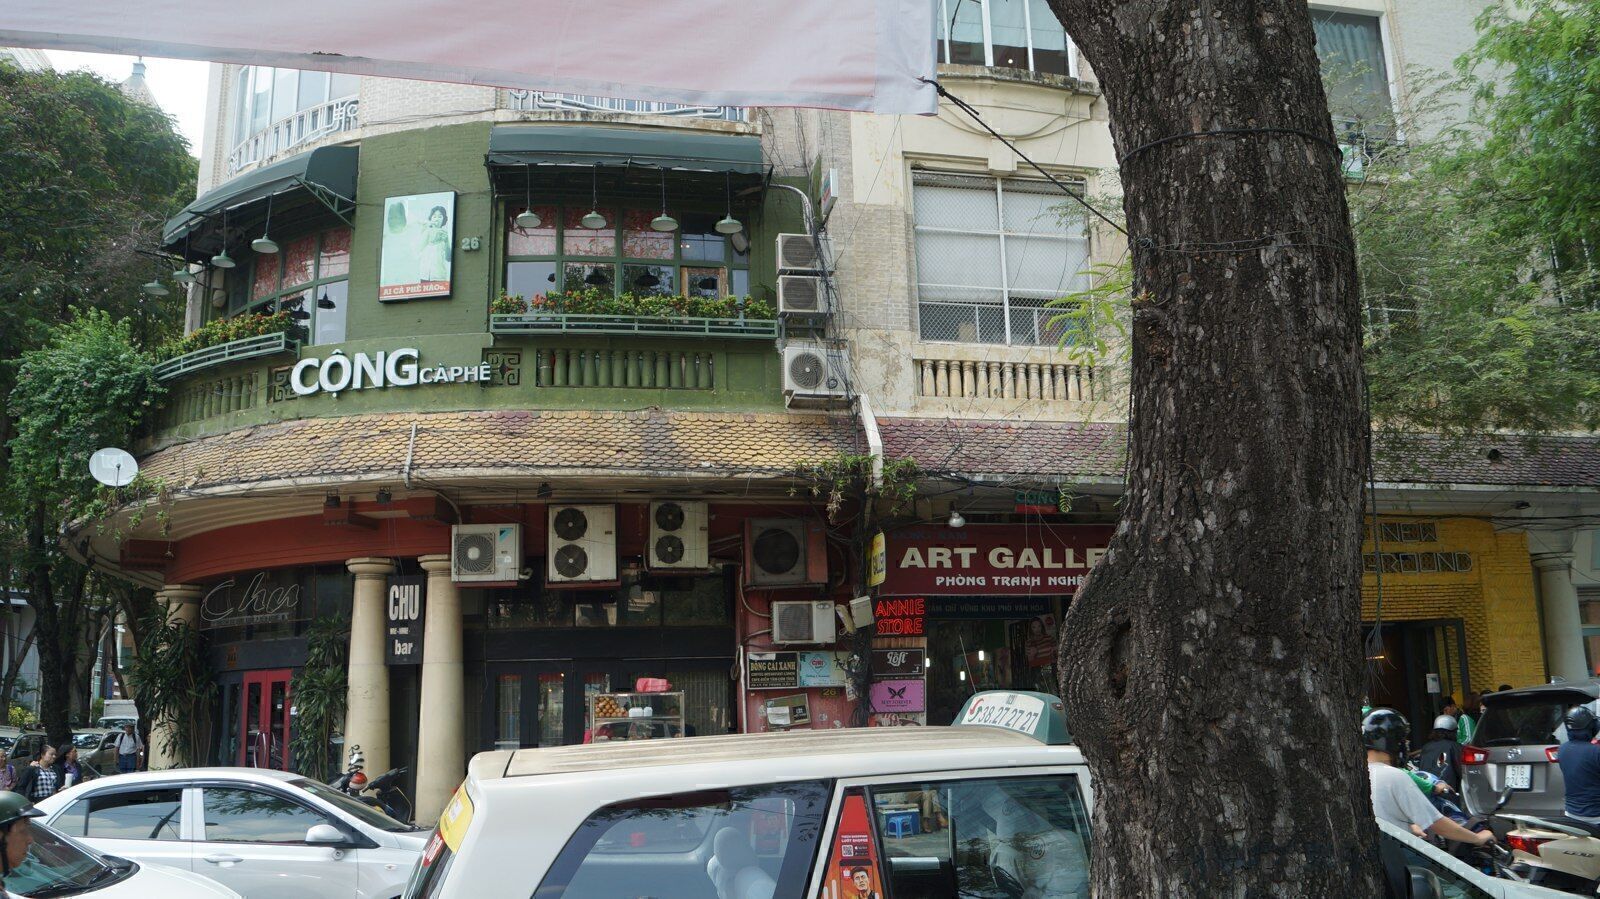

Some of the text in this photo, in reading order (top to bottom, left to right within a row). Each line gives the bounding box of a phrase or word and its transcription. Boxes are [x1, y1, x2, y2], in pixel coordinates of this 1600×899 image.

[461, 237, 479, 250] 26
[290, 347, 419, 398] CỘNG
[1381, 522, 1440, 542] NEW
[900, 547, 977, 569] ART
[936, 573, 986, 587] PHÒNG
[992, 576, 1041, 587] TRANH
[388, 584, 420, 621] CHU
[876, 599, 925, 617] ANNIE
[877, 618, 923, 634] STORE
[394, 639, 414, 655] bar
[822, 687, 836, 696] 26
